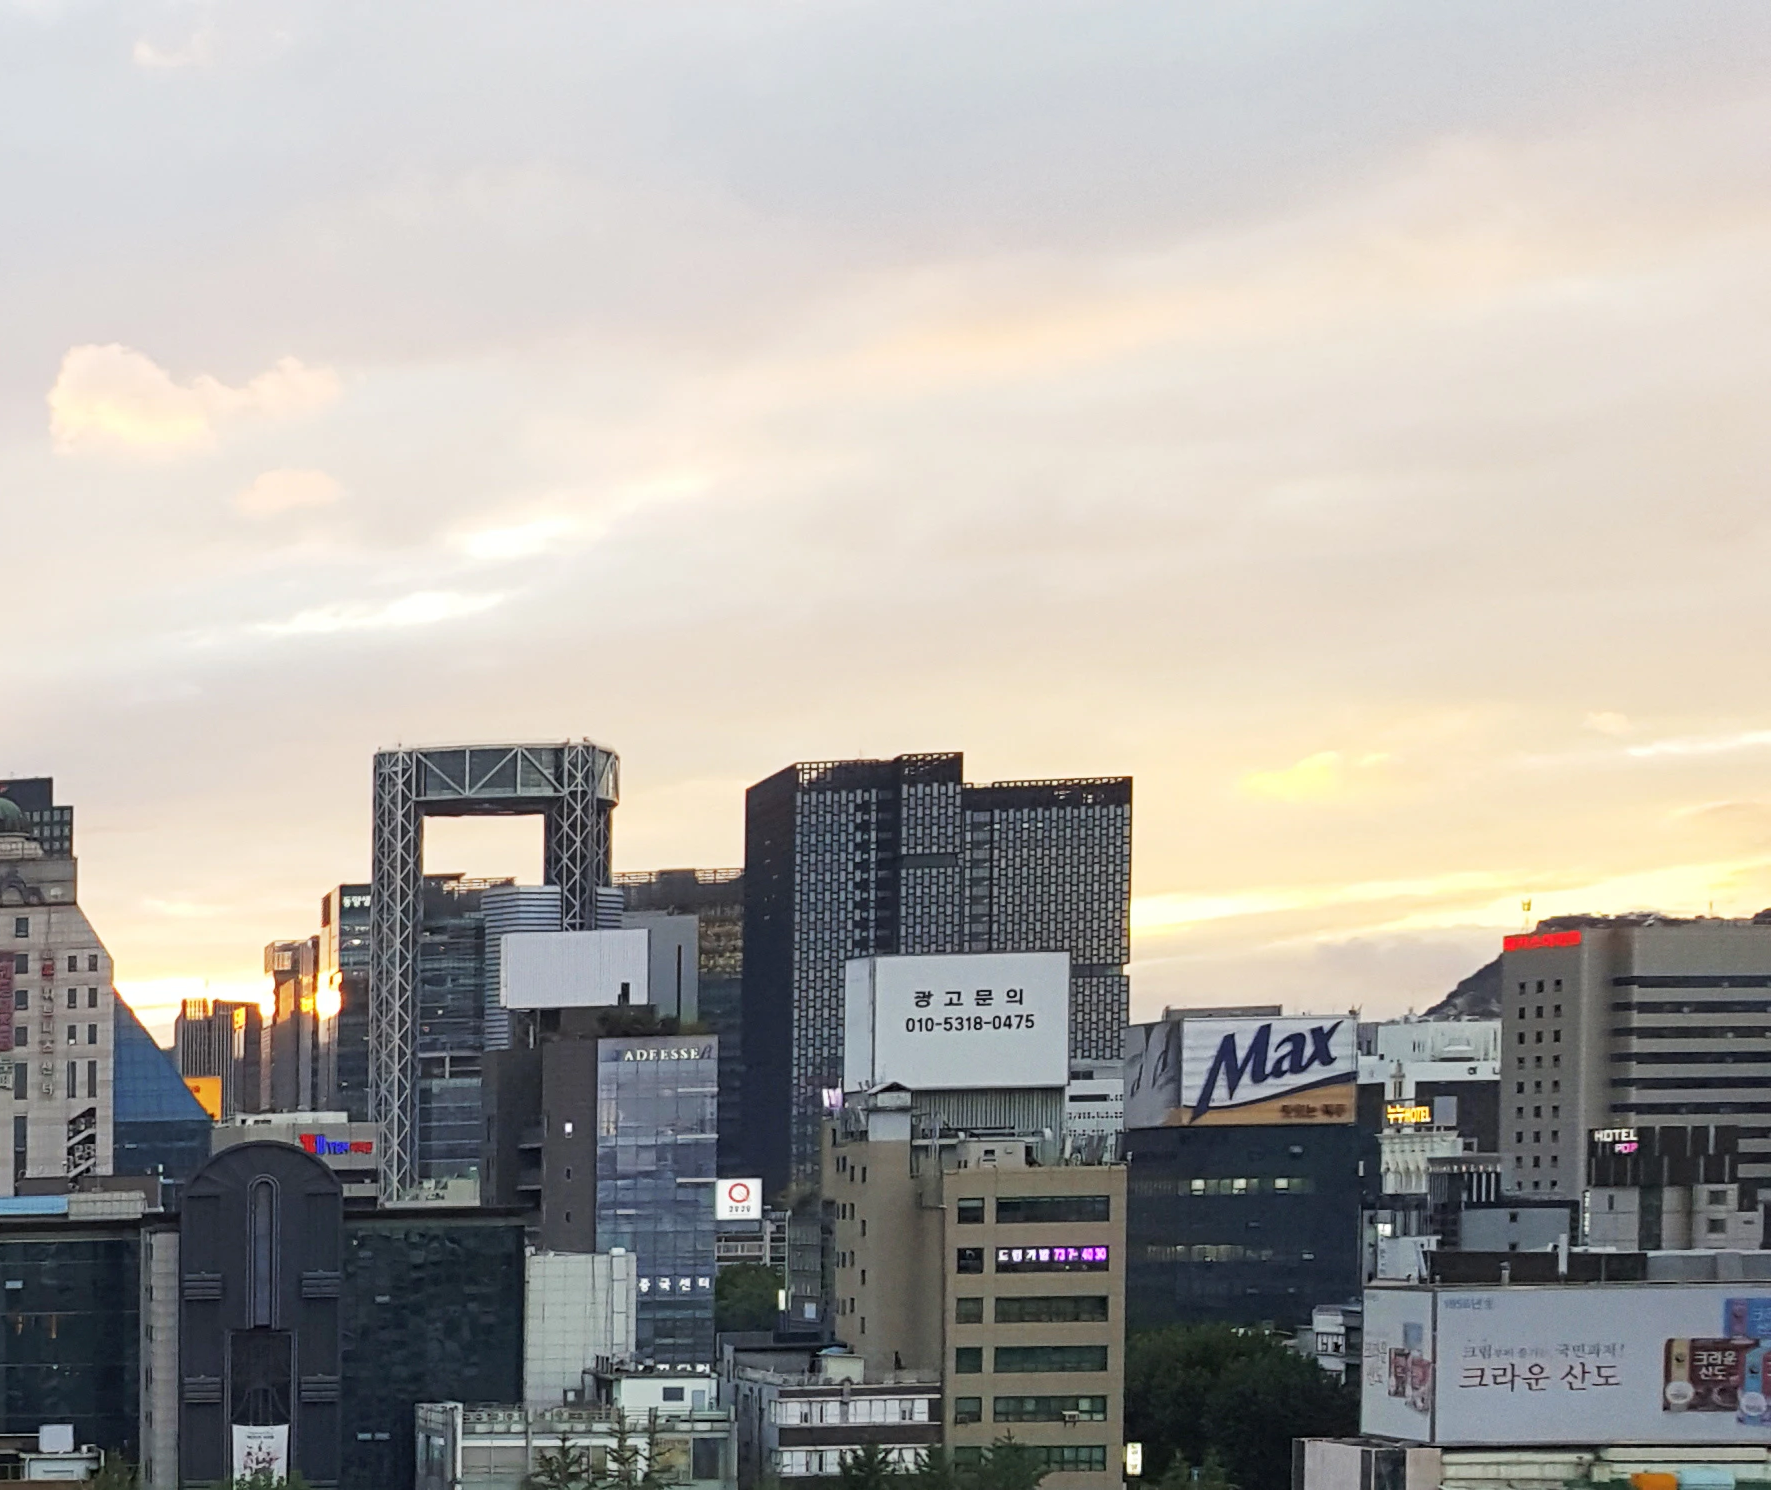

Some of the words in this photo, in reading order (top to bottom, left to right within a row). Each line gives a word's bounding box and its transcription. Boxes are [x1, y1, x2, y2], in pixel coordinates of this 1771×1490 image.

[914, 988, 1023, 1008] 광고문의
[906, 1014, 1035, 1032] 010-5318-0475
[1188, 1019, 1344, 1124] Max
[1594, 1129, 1638, 1141] HOTEL
[1694, 1351, 1737, 1366] 크라운
[1459, 1362, 1550, 1392] 크라운
[1560, 1361, 1621, 1392] 산도
